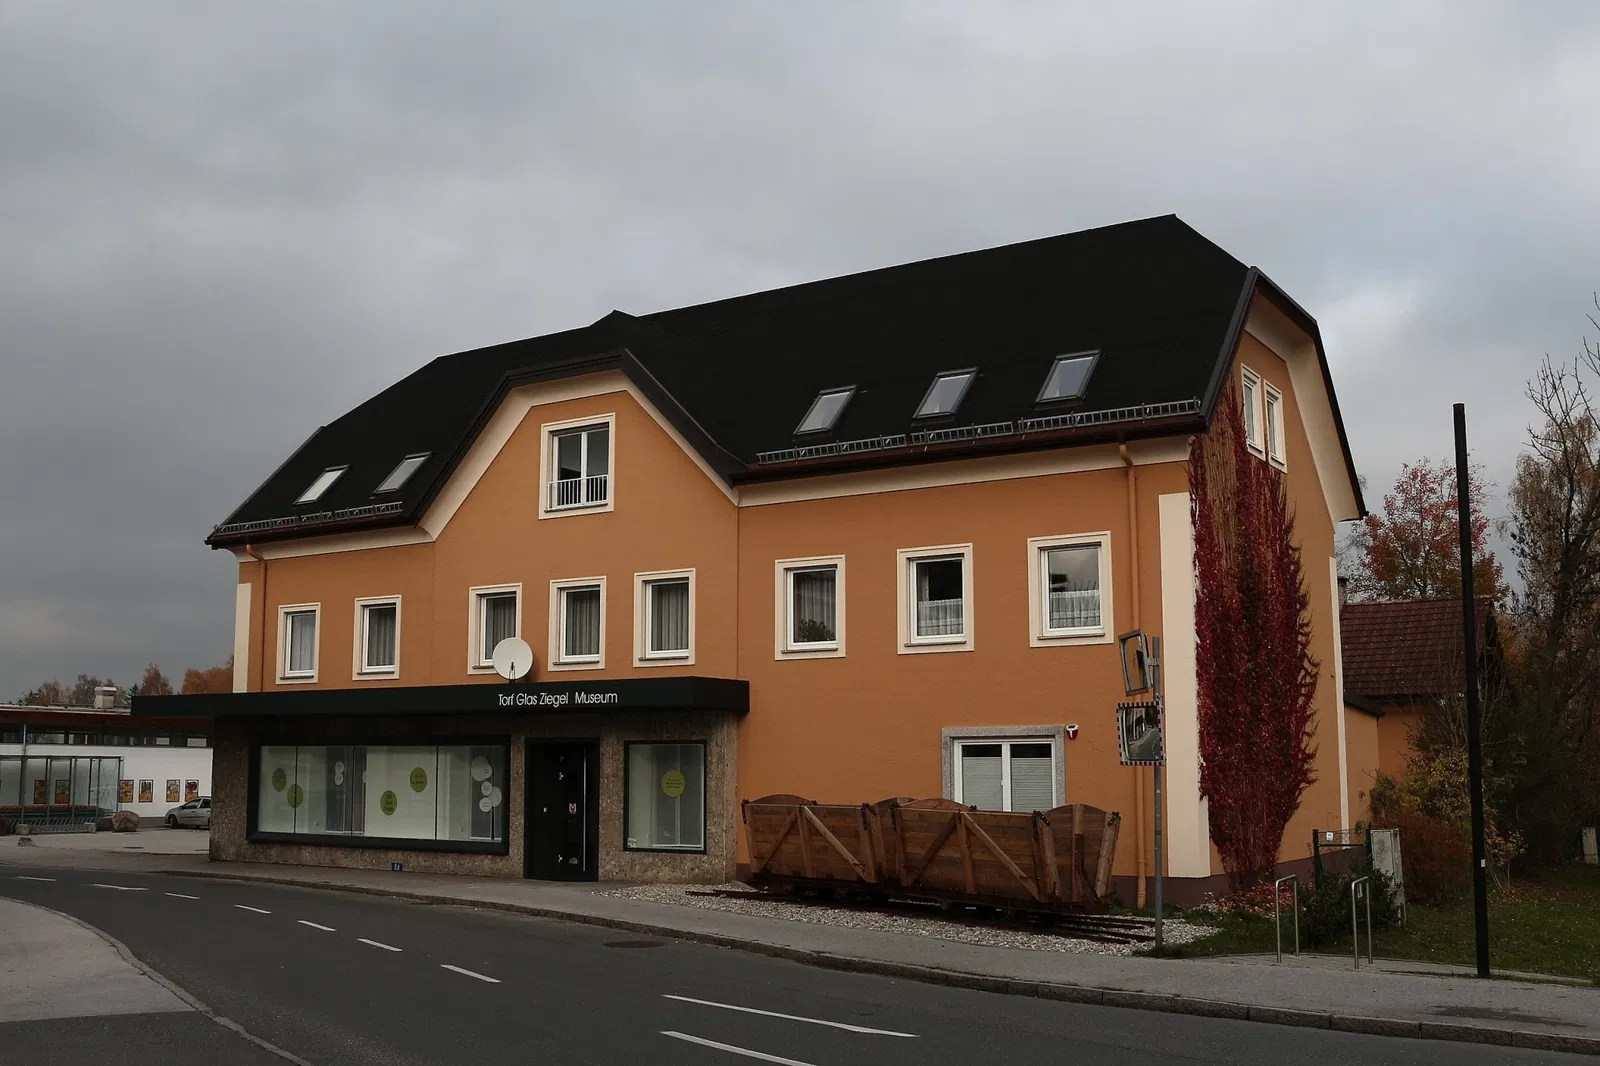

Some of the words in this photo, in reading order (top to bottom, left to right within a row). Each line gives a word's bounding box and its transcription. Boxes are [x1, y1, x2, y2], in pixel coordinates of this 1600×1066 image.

[498, 693, 515, 706] Torf
[516, 692, 538, 706] Glas
[539, 692, 569, 707] Ziegel
[574, 691, 618, 704] Museum
